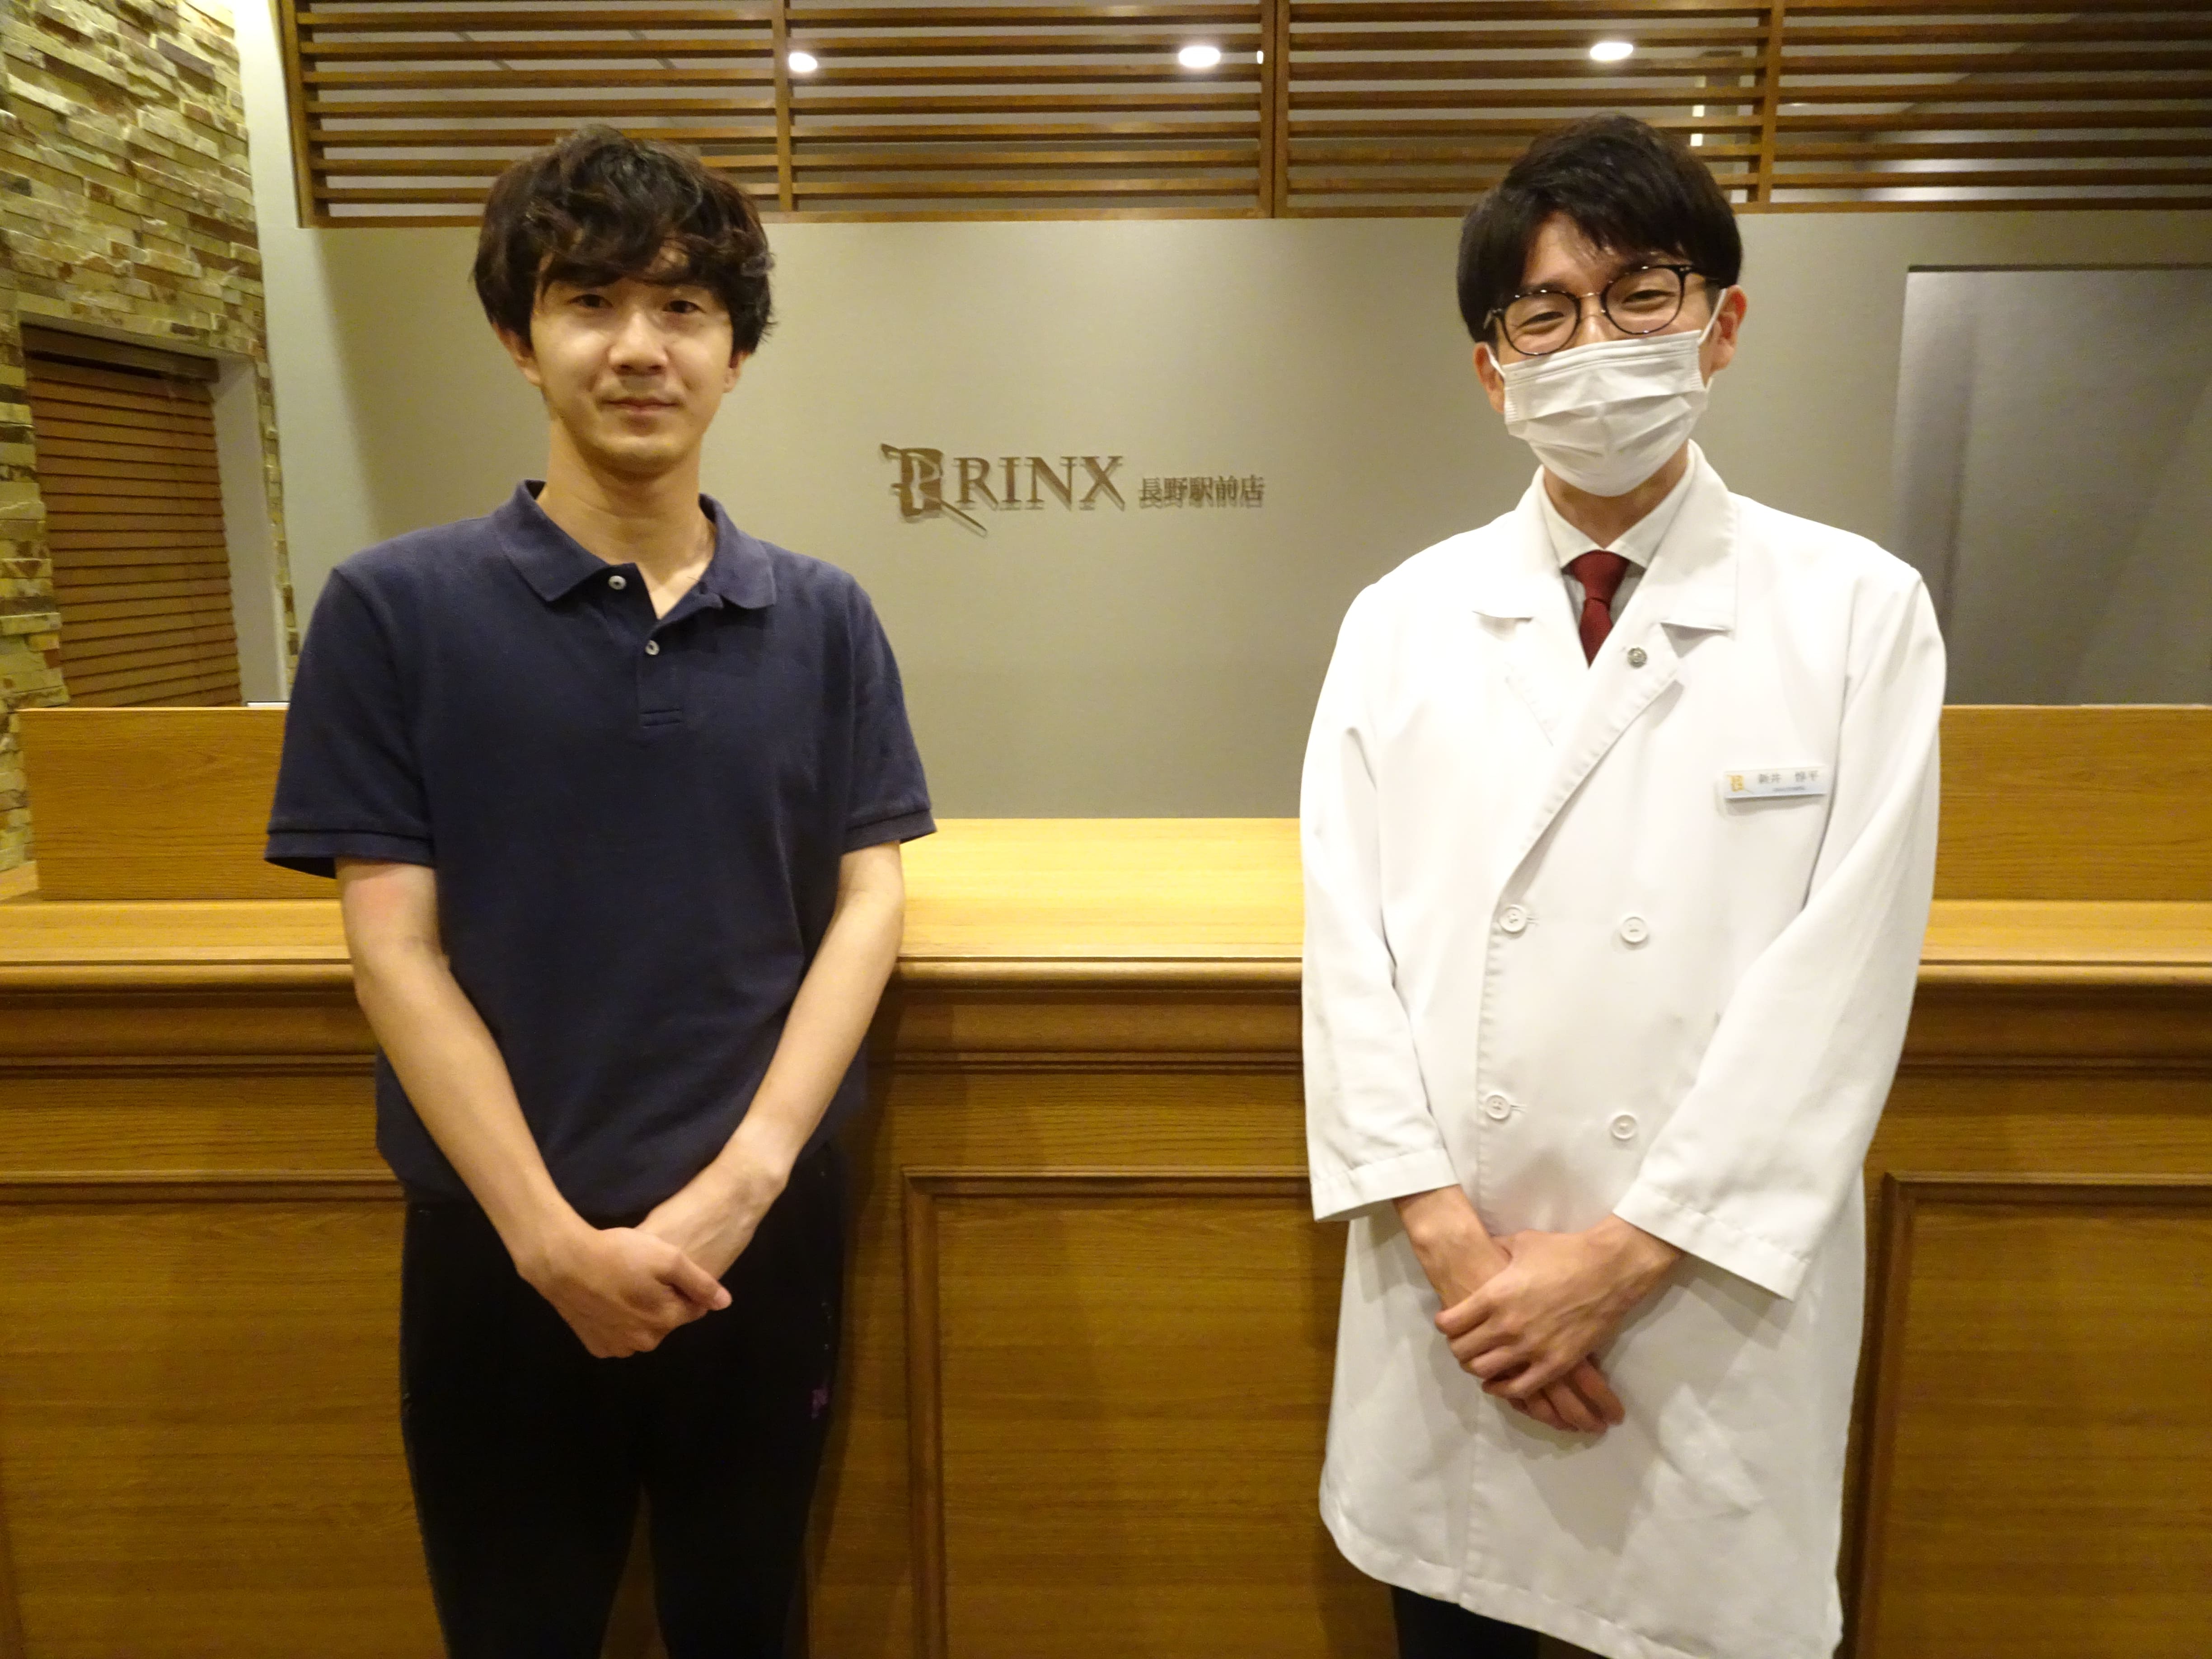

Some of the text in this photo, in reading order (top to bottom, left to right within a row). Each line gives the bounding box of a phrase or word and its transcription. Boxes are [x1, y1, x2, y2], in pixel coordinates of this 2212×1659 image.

[1138, 474, 1265, 502] 長野駅前店
